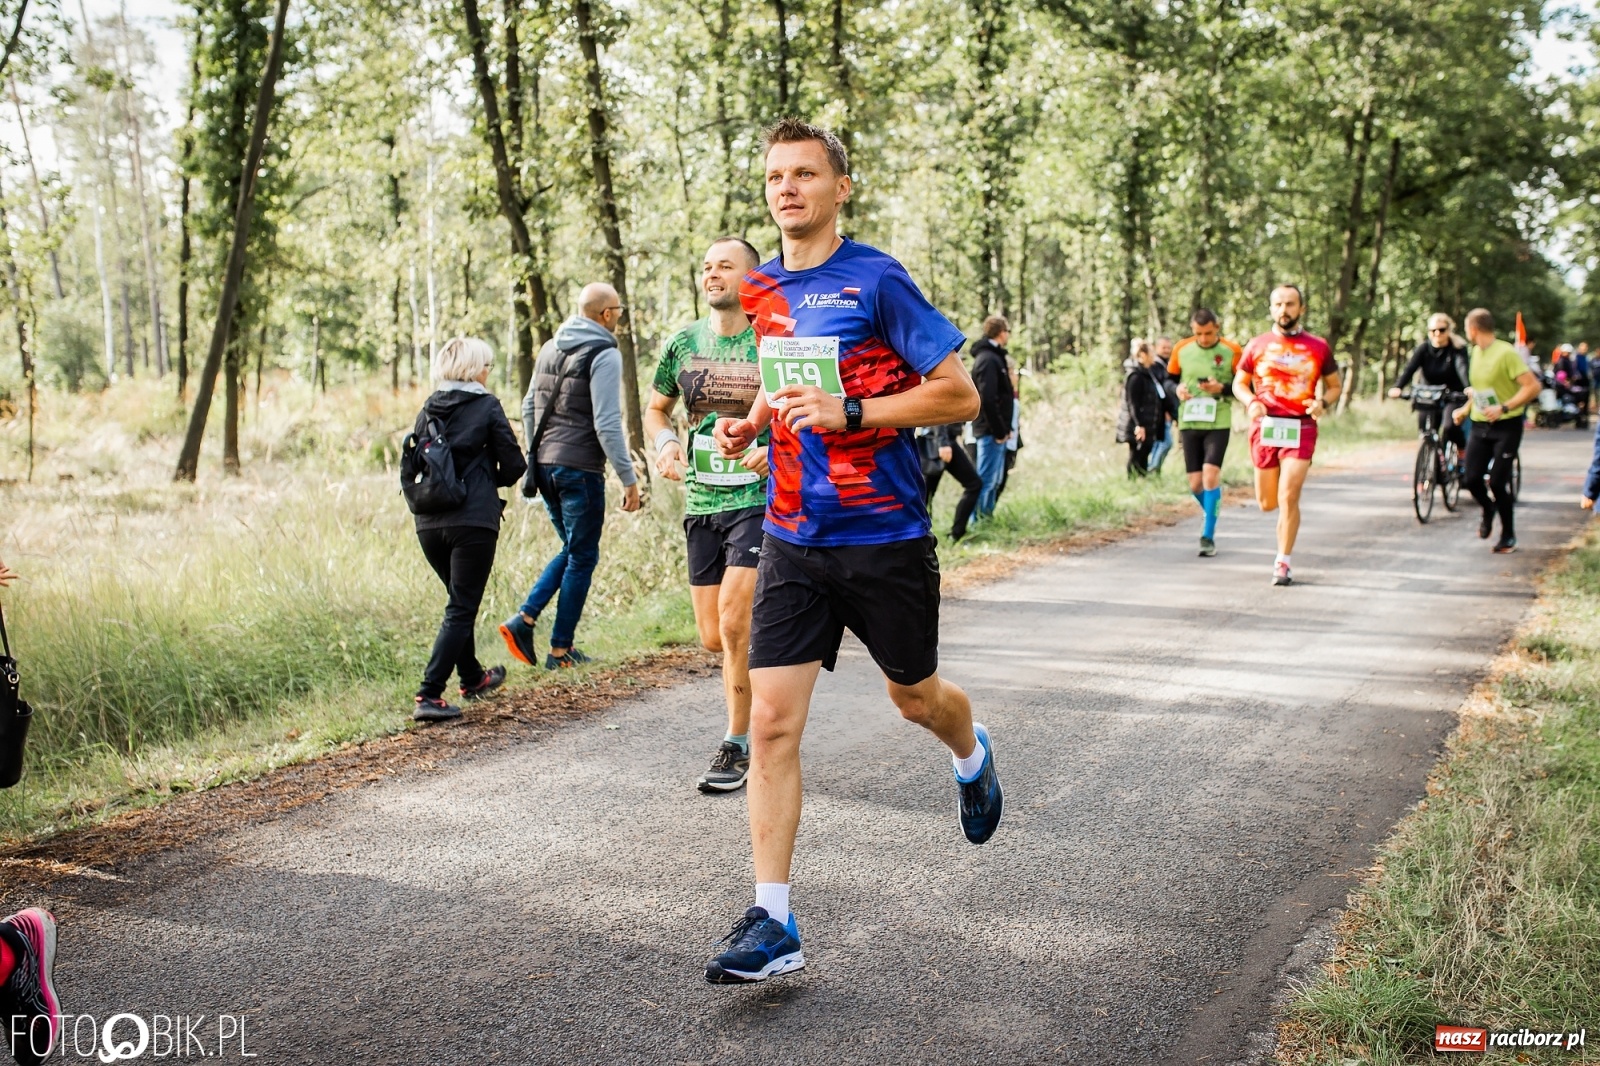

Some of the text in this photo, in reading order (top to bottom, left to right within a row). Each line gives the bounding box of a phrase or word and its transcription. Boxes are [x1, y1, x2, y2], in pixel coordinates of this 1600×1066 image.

[797, 293, 818, 308] XI
[774, 361, 822, 389] 159
[709, 452, 736, 473] 67
